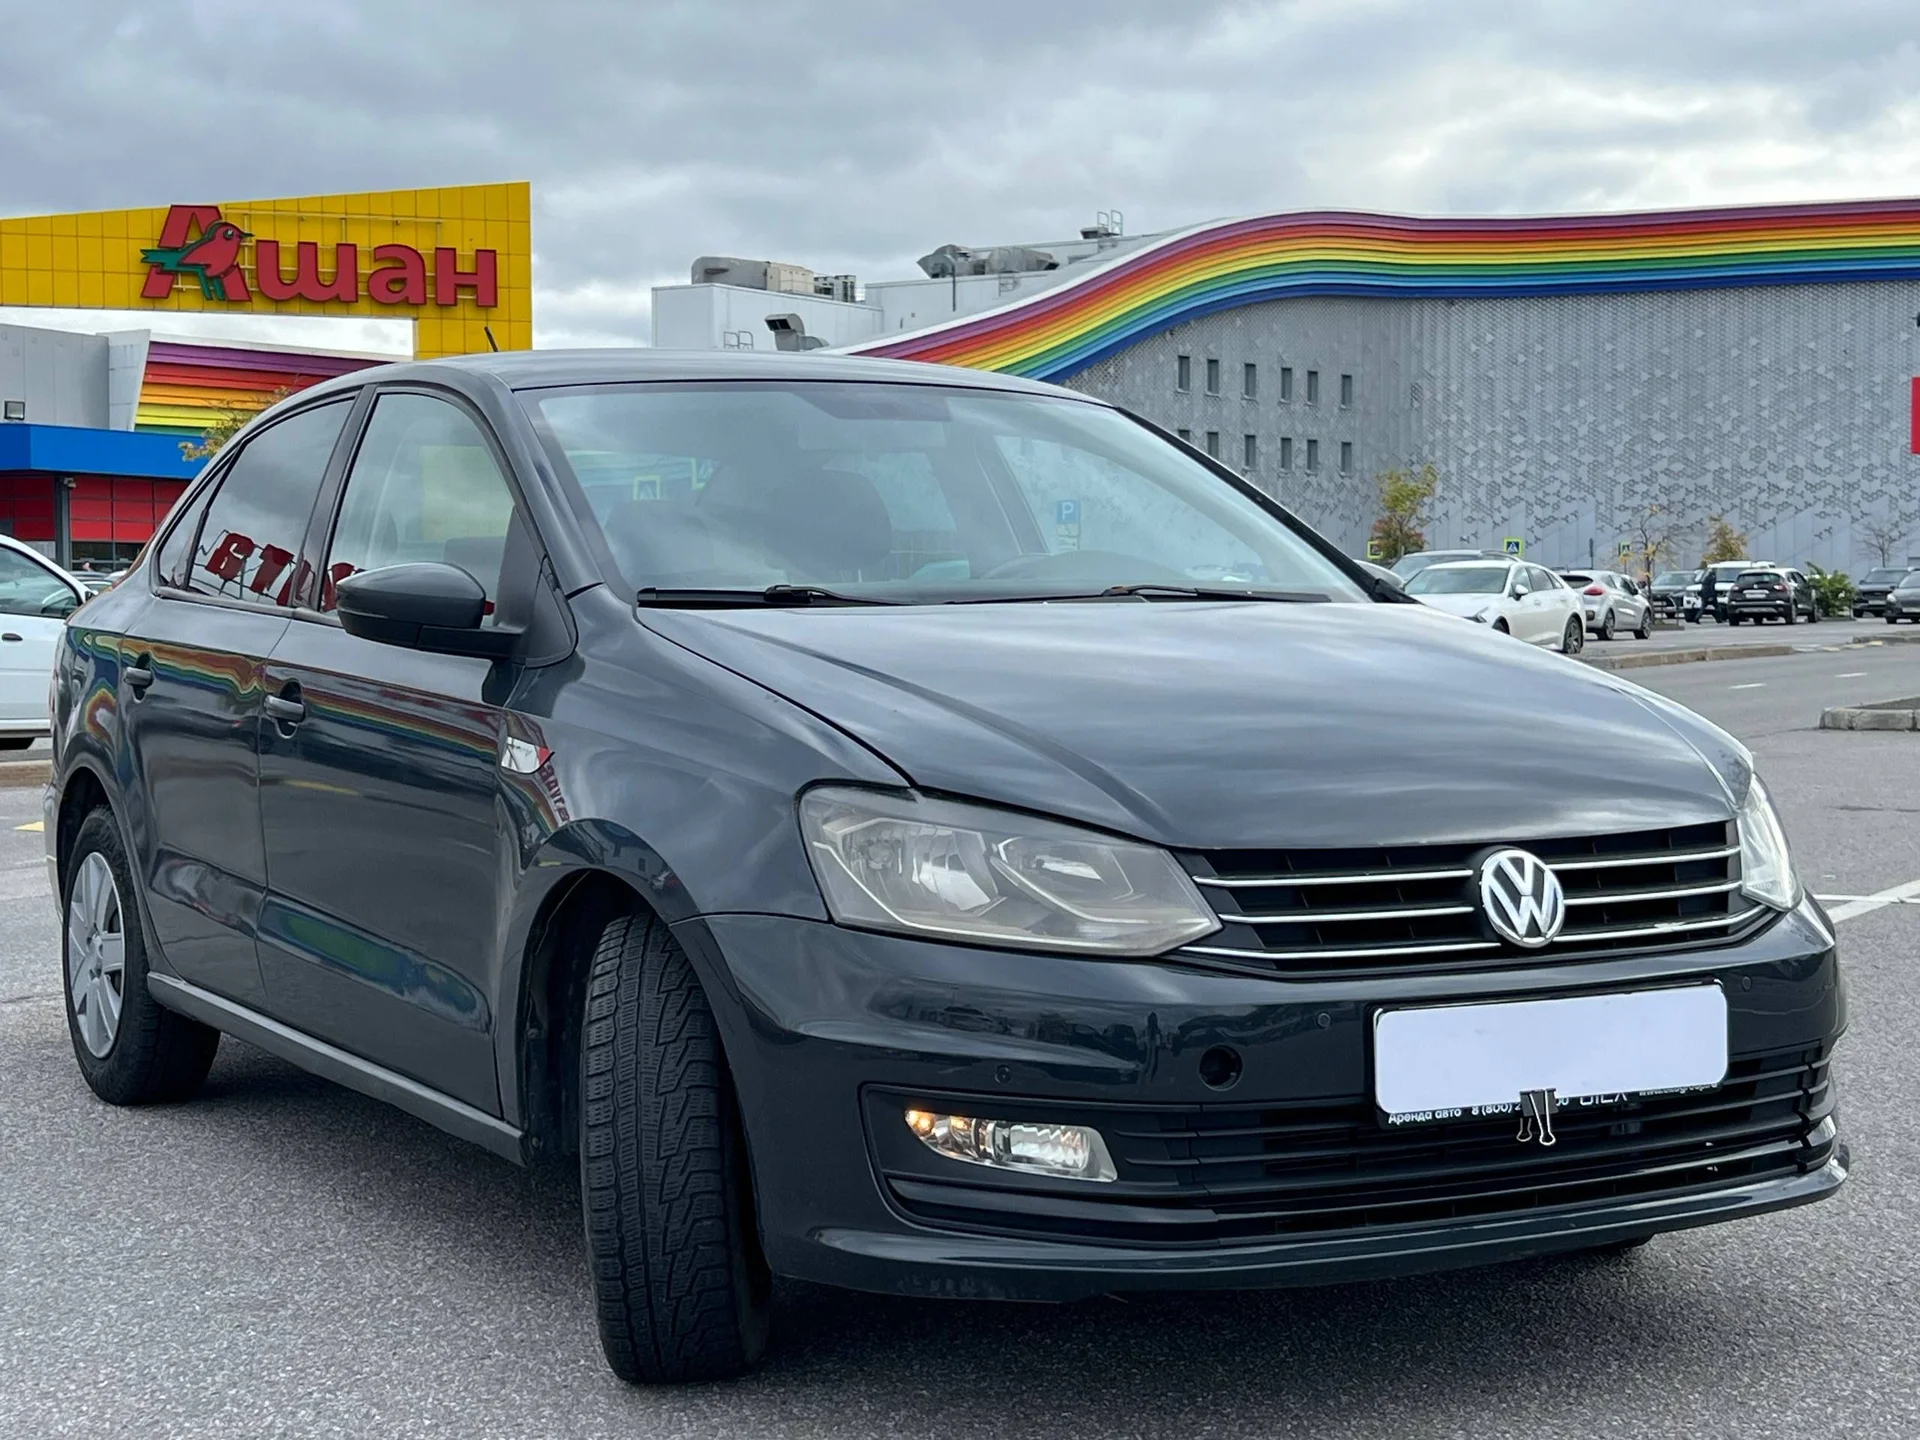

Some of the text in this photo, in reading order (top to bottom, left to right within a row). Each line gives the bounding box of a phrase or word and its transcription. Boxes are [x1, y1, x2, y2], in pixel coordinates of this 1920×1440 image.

[140, 204, 498, 308] Ашан
[1060, 501, 1075, 521] P
[1478, 850, 1566, 943] VW
[1388, 1111, 1433, 1126] Аренда
[1434, 1108, 1463, 1119] авто
[1471, 1106, 1480, 1116] 8
